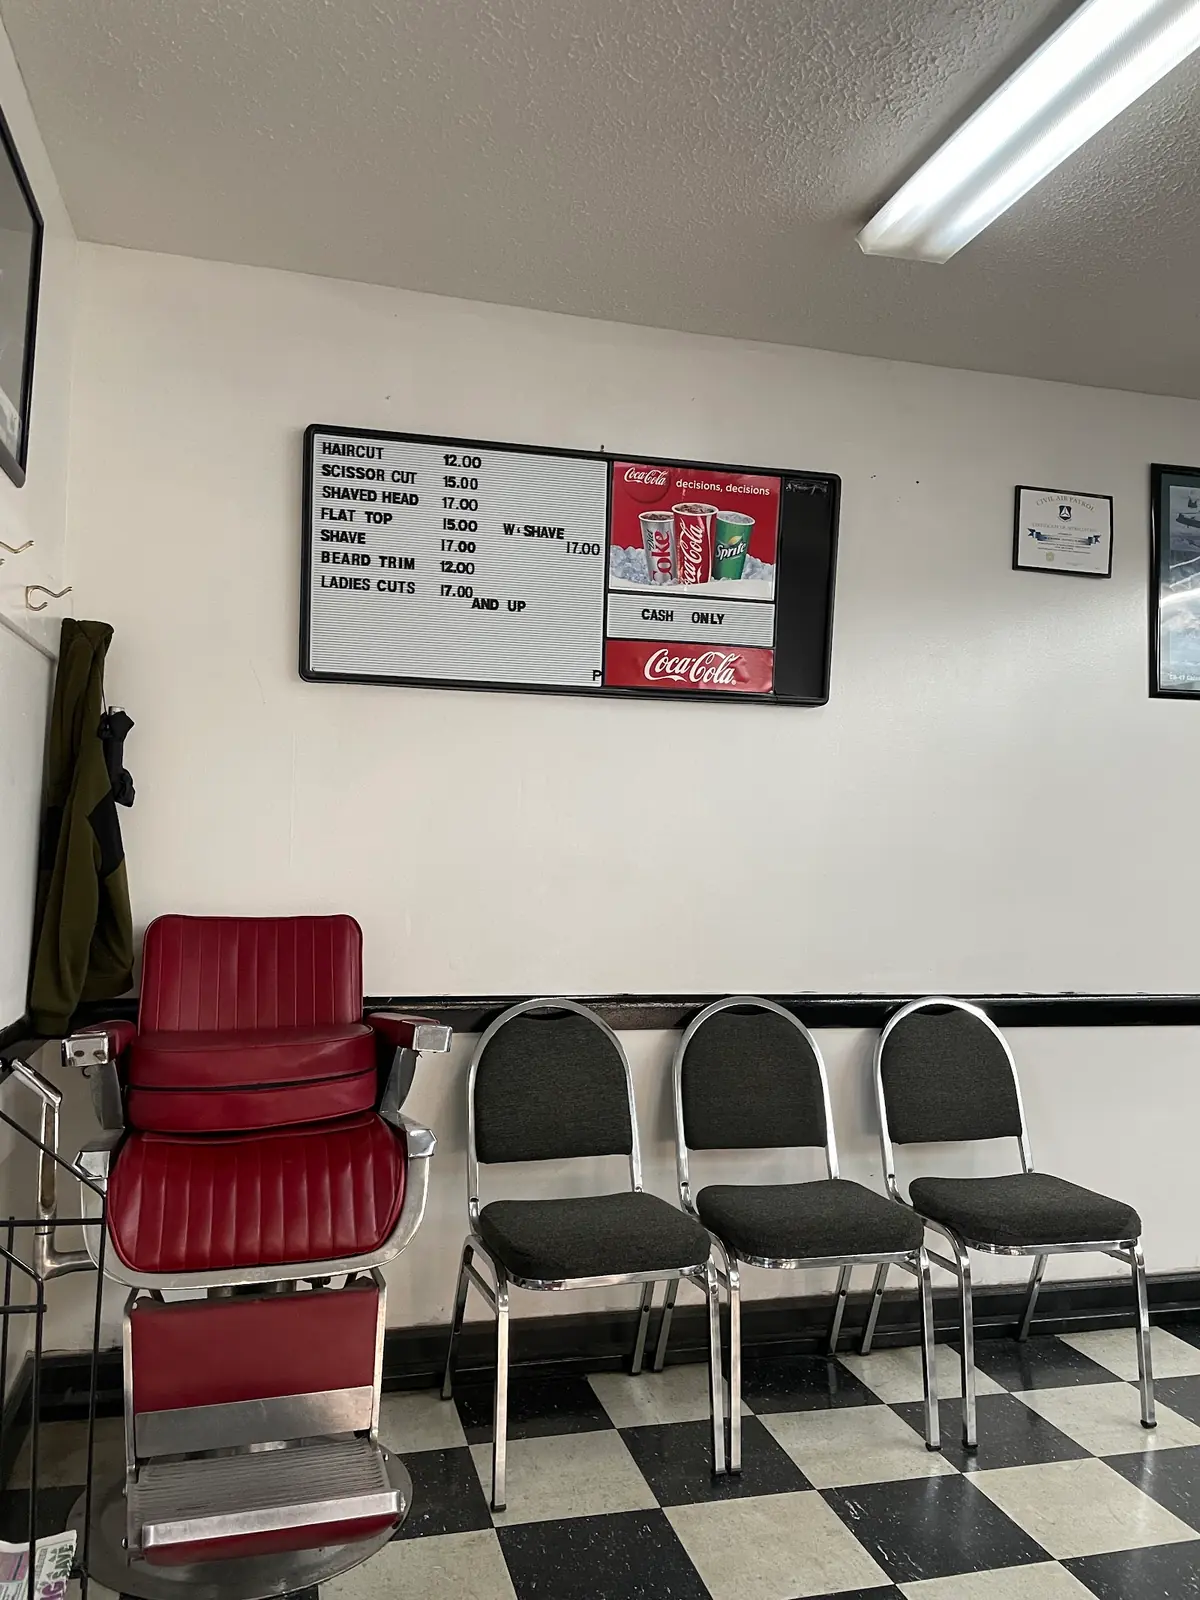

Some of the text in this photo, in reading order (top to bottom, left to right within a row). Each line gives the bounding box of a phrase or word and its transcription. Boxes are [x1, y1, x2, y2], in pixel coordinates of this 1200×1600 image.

[321, 442, 482, 469] HAIRCUT 12.00
[321, 464, 478, 490] SCISSOR CUT 15.00
[624, 467, 669, 486] Coca-Cola
[676, 479, 771, 496] decisions, decisions
[322, 486, 478, 511] SHAVED HEAD 17.00
[321, 508, 356, 522] FLAT
[365, 511, 393, 525] TOP
[443, 518, 478, 532] 15.00
[320, 529, 476, 554] SHAVE 17.00
[566, 542, 600, 556] 17.00
[680, 517, 704, 585] ca-Cola
[715, 542, 746, 561] Sprite
[321, 551, 475, 575] BEARD TRIM 12.00
[321, 576, 473, 599] LADIES CUTS 17.00
[471, 598, 526, 612] AND UP
[641, 609, 725, 624] CASH ONLY
[644, 648, 739, 685] Coca-Cola
